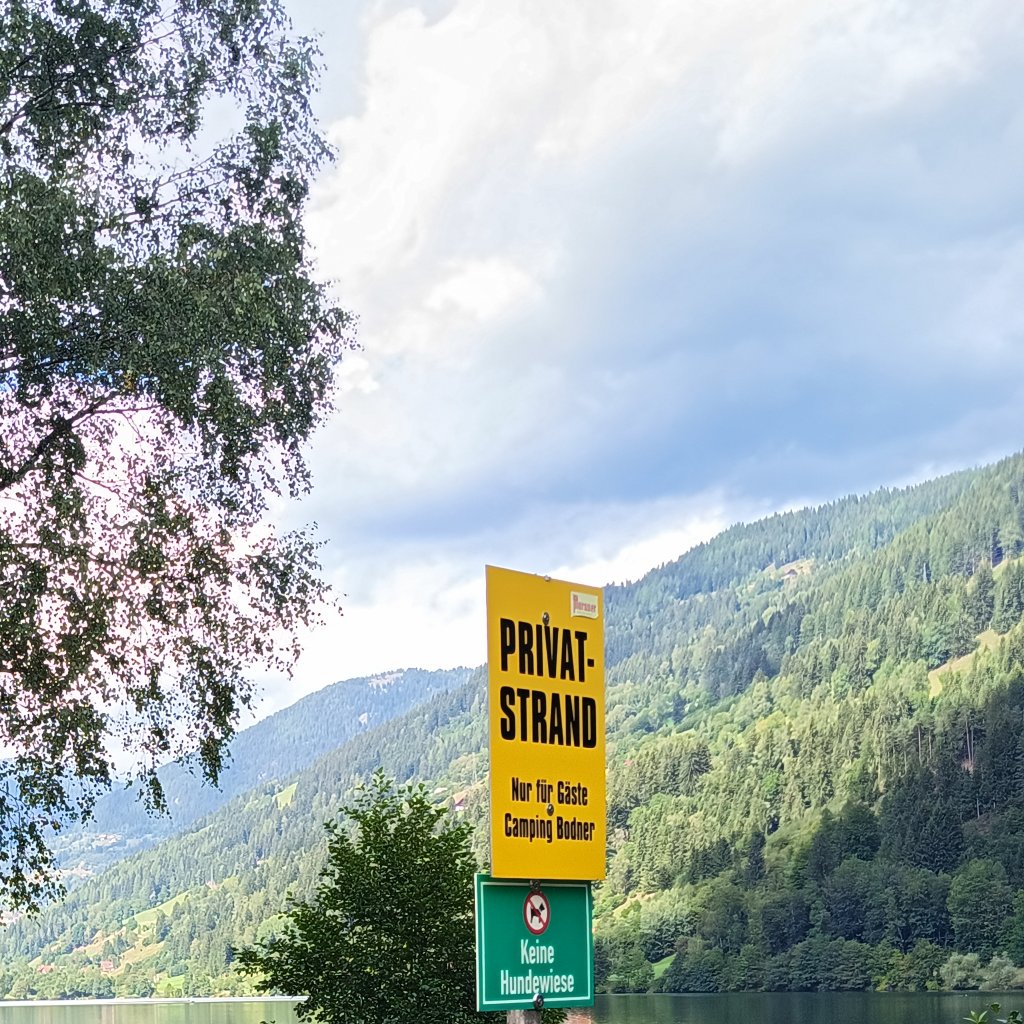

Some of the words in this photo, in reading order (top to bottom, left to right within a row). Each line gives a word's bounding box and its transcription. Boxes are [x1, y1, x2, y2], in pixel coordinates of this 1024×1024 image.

[500, 618, 595, 682] PRIVAT-
[500, 686, 597, 748] STRAND
[511, 777, 532, 802] Nur
[536, 779, 553, 803] für
[557, 781, 588, 806] Gäste
[504, 813, 553, 843] Camping
[556, 816, 595, 841] Bodner
[520, 939, 555, 964] Keine
[500, 968, 575, 995] Hundewiese
